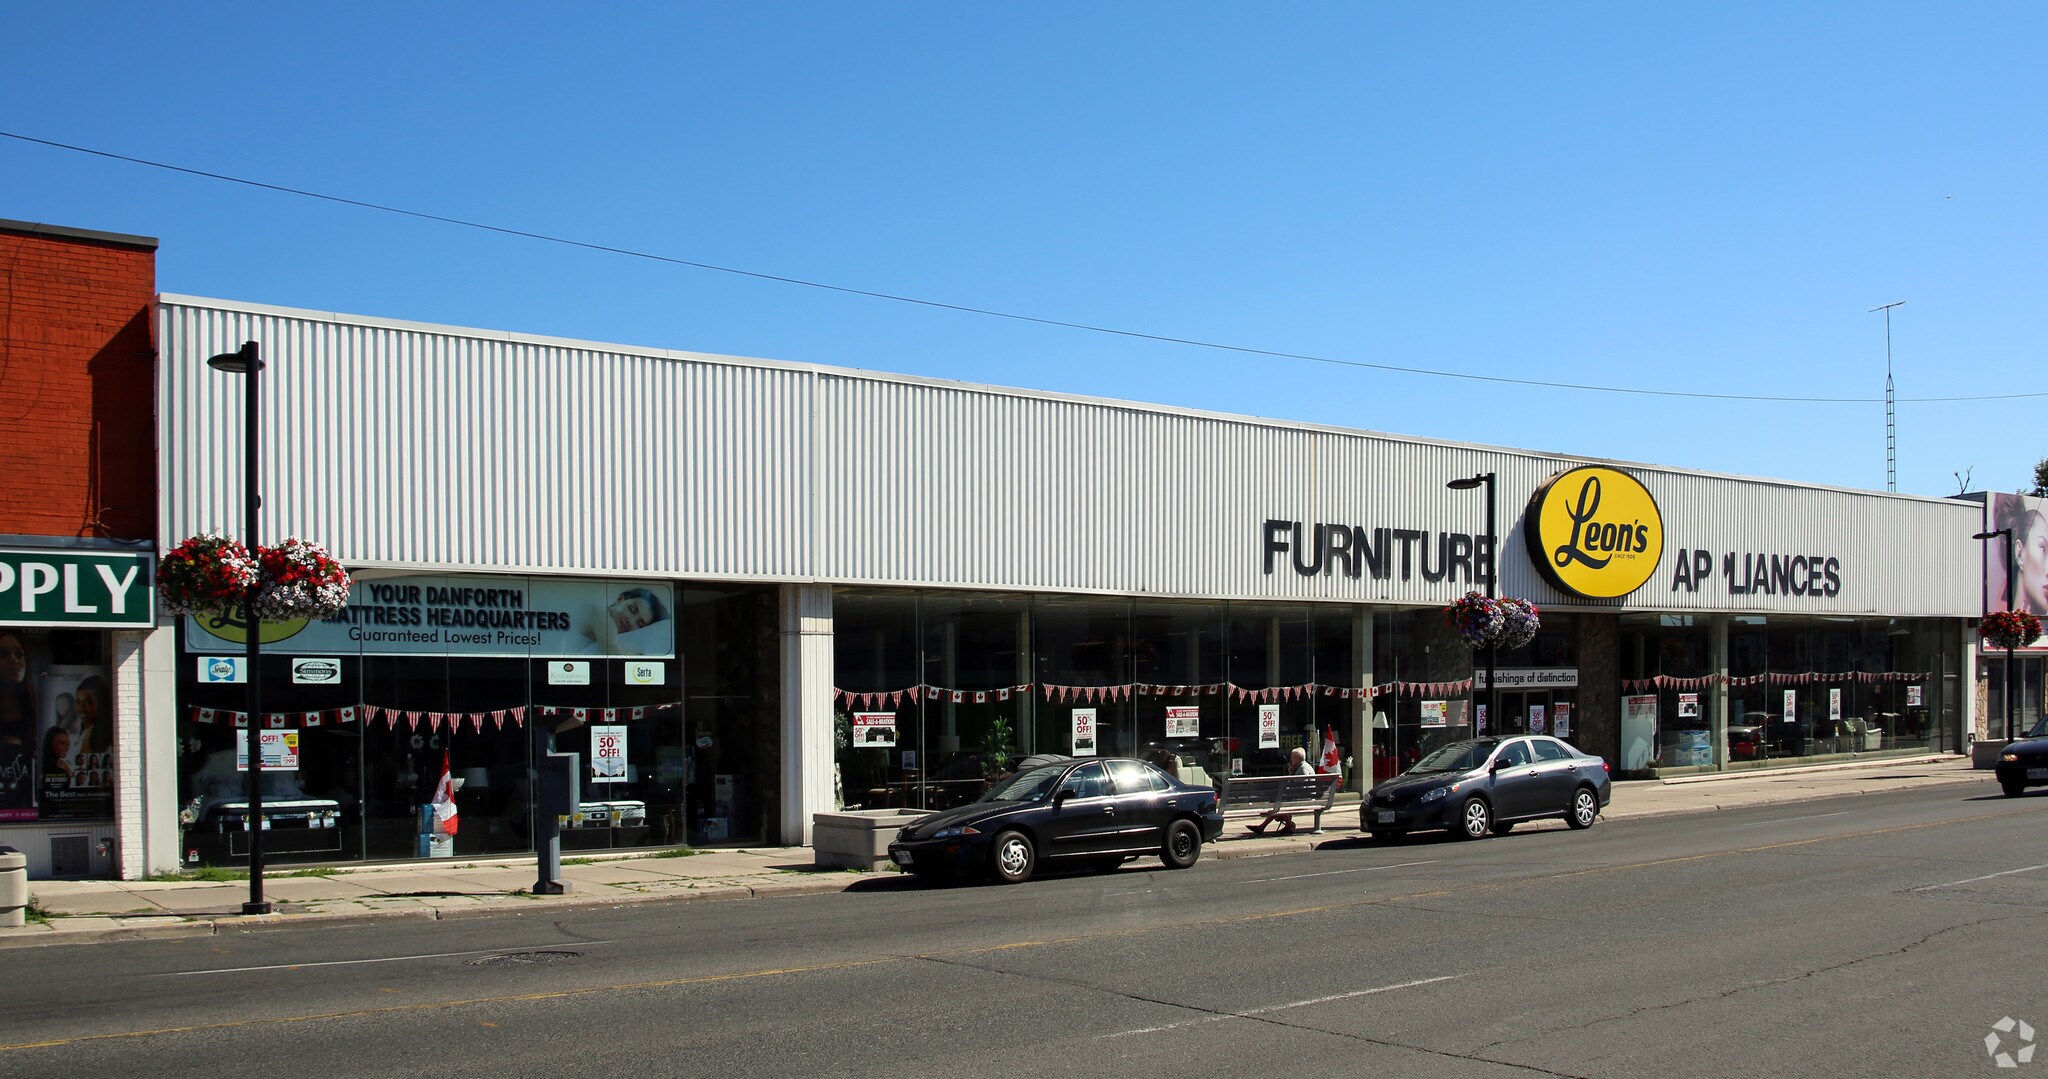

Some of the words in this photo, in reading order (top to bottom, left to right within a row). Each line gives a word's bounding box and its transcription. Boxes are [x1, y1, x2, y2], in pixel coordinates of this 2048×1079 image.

[1554, 476, 1648, 570] Leon's
[1263, 519, 1498, 585] FURNITURE
[1671, 548, 1841, 597] APLIANCES
[369, 584, 421, 604] YOUR
[426, 586, 524, 608] DANFORTH
[321, 604, 422, 627] ATTRESS
[426, 607, 571, 631] HEADQUARTERS
[348, 627, 439, 643] Guaranteed
[444, 629, 492, 645] Lowest
[497, 631, 542, 646] Prices!
[211, 664, 231, 675] Sealy
[299, 667, 332, 675] Simmons
[636, 667, 652, 677] Serta
[1478, 672, 1525, 685] fuishings
[1527, 672, 1535, 683] of
[1537, 672, 1576, 683] distinction
[599, 748, 620, 758] OFF!
[60, 790, 76, 798] Best
